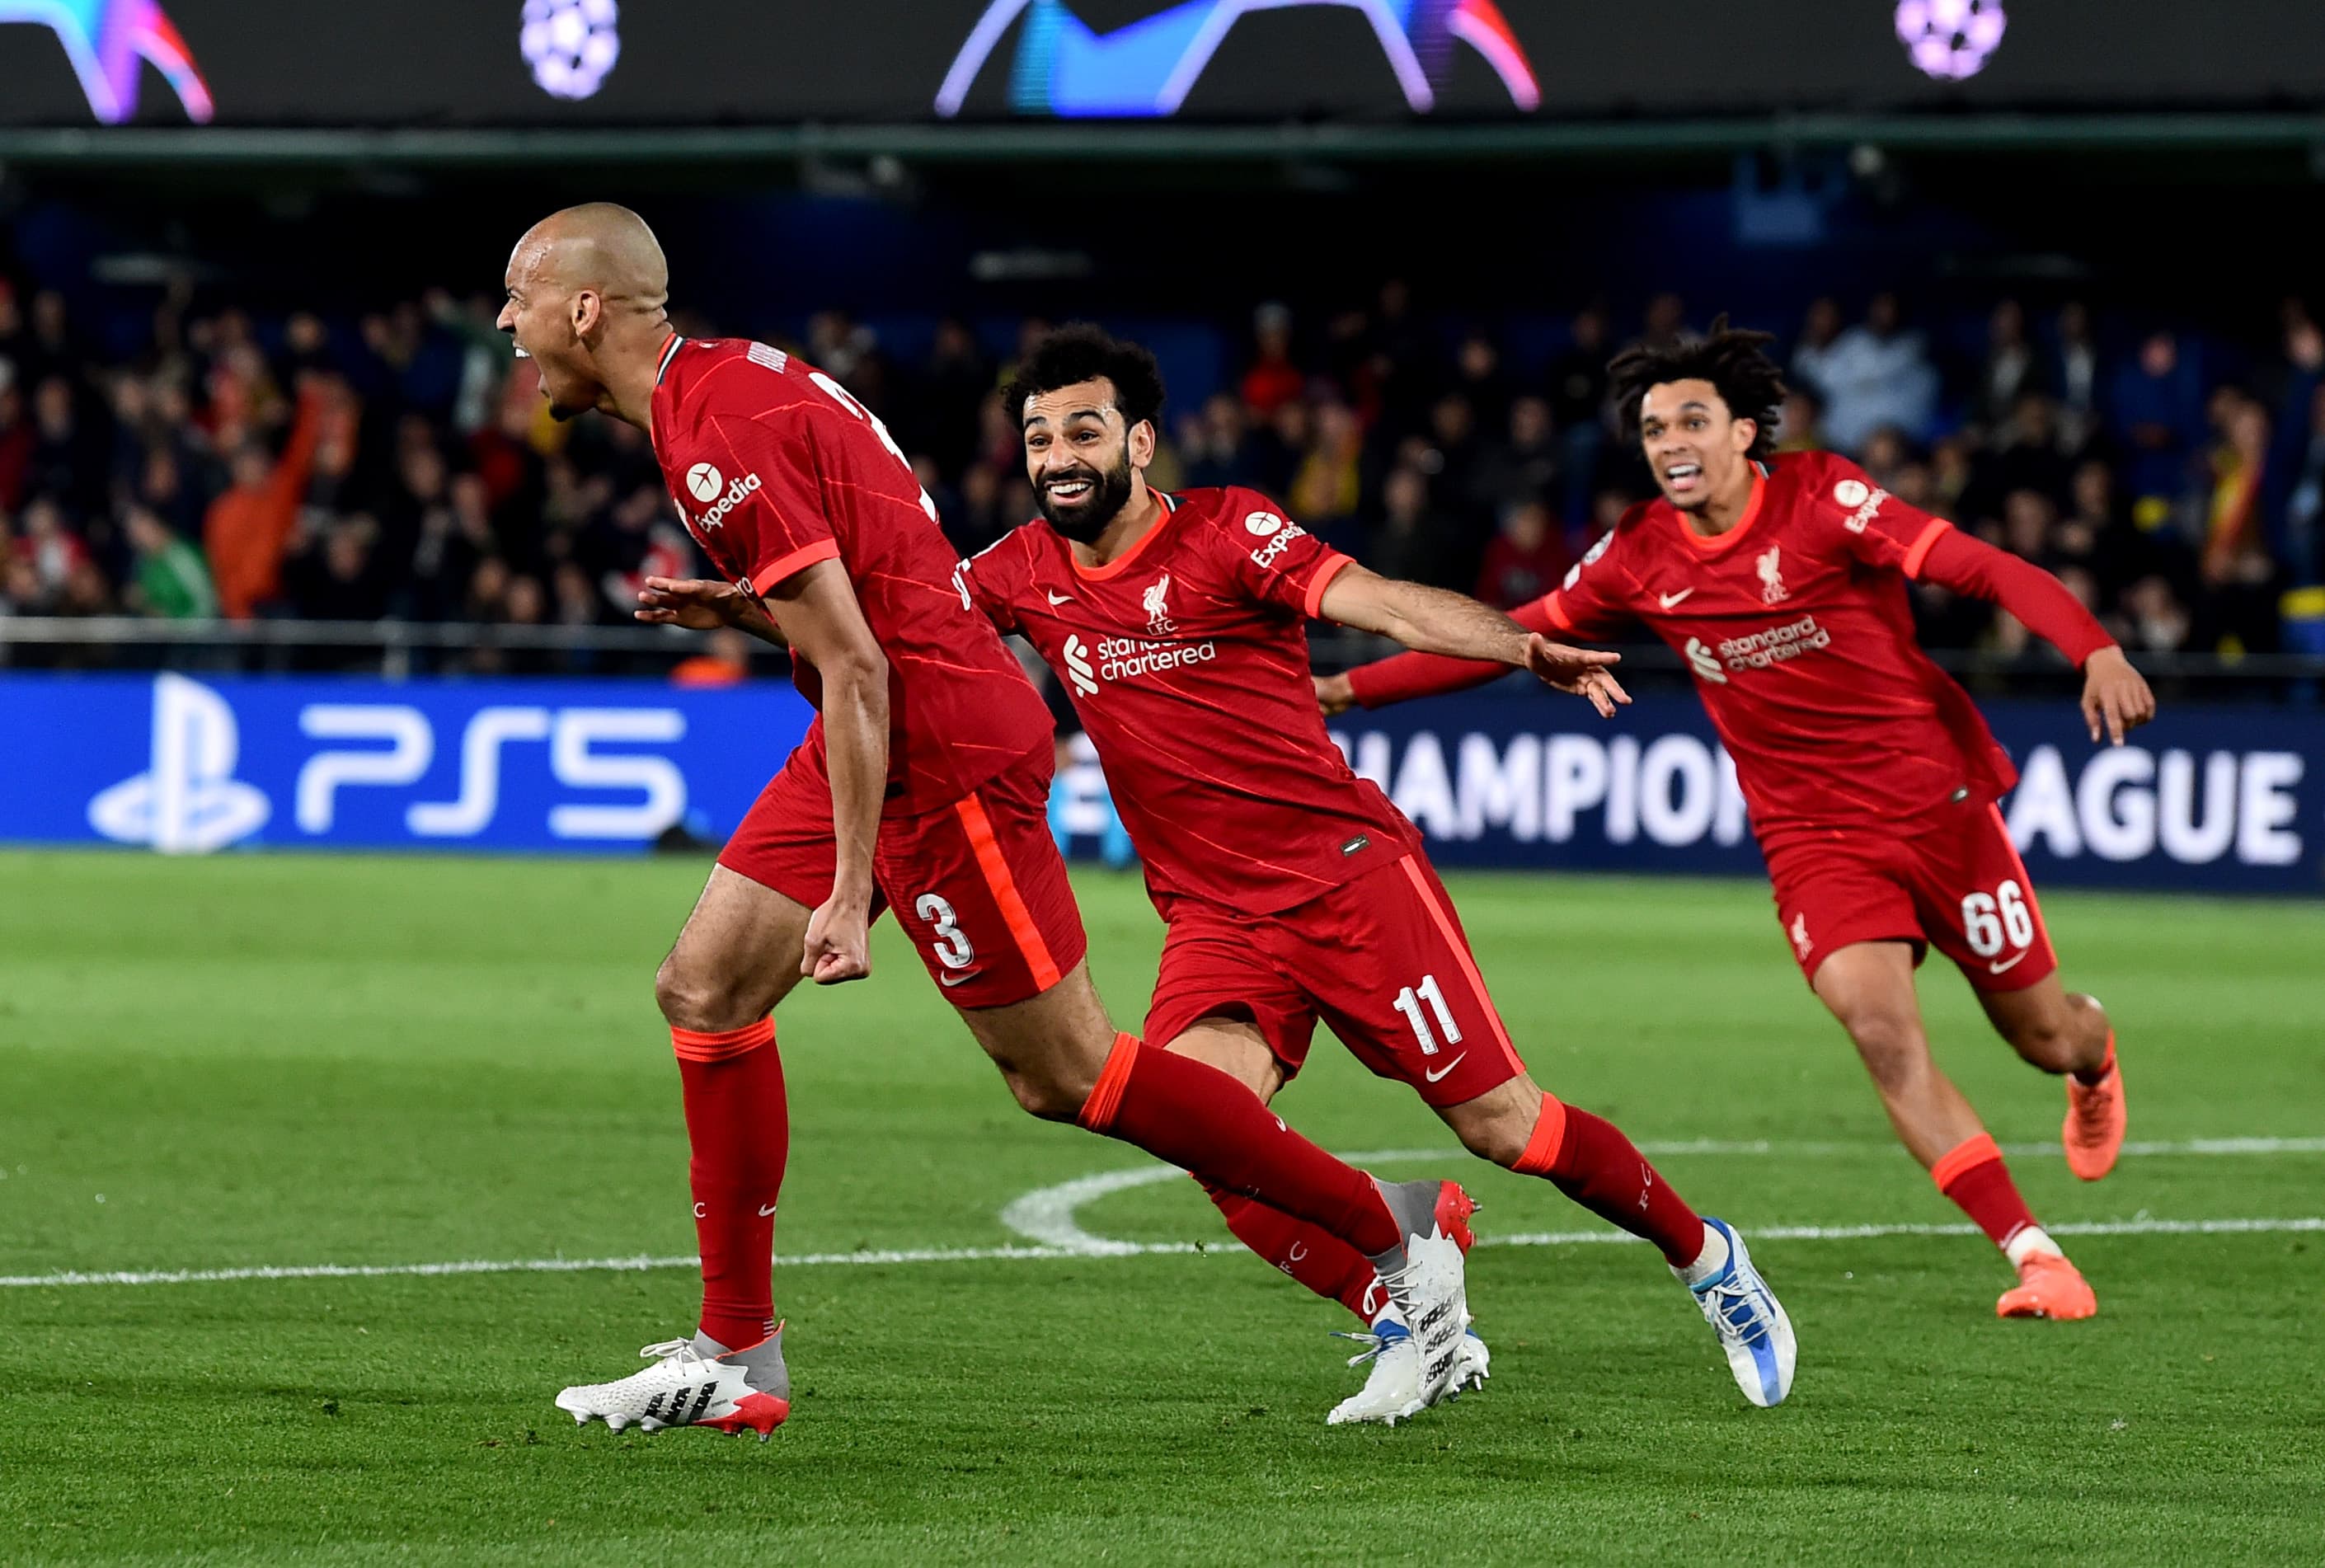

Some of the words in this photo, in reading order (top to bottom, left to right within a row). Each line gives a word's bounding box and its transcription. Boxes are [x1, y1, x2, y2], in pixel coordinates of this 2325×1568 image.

[1101, 641, 1216, 681] chartered
[1718, 614, 1817, 658] standard
[296, 703, 688, 839] PS5
[916, 893, 975, 969] 3
[1961, 880, 2034, 957] 66
[1392, 974, 1463, 1055] 11
